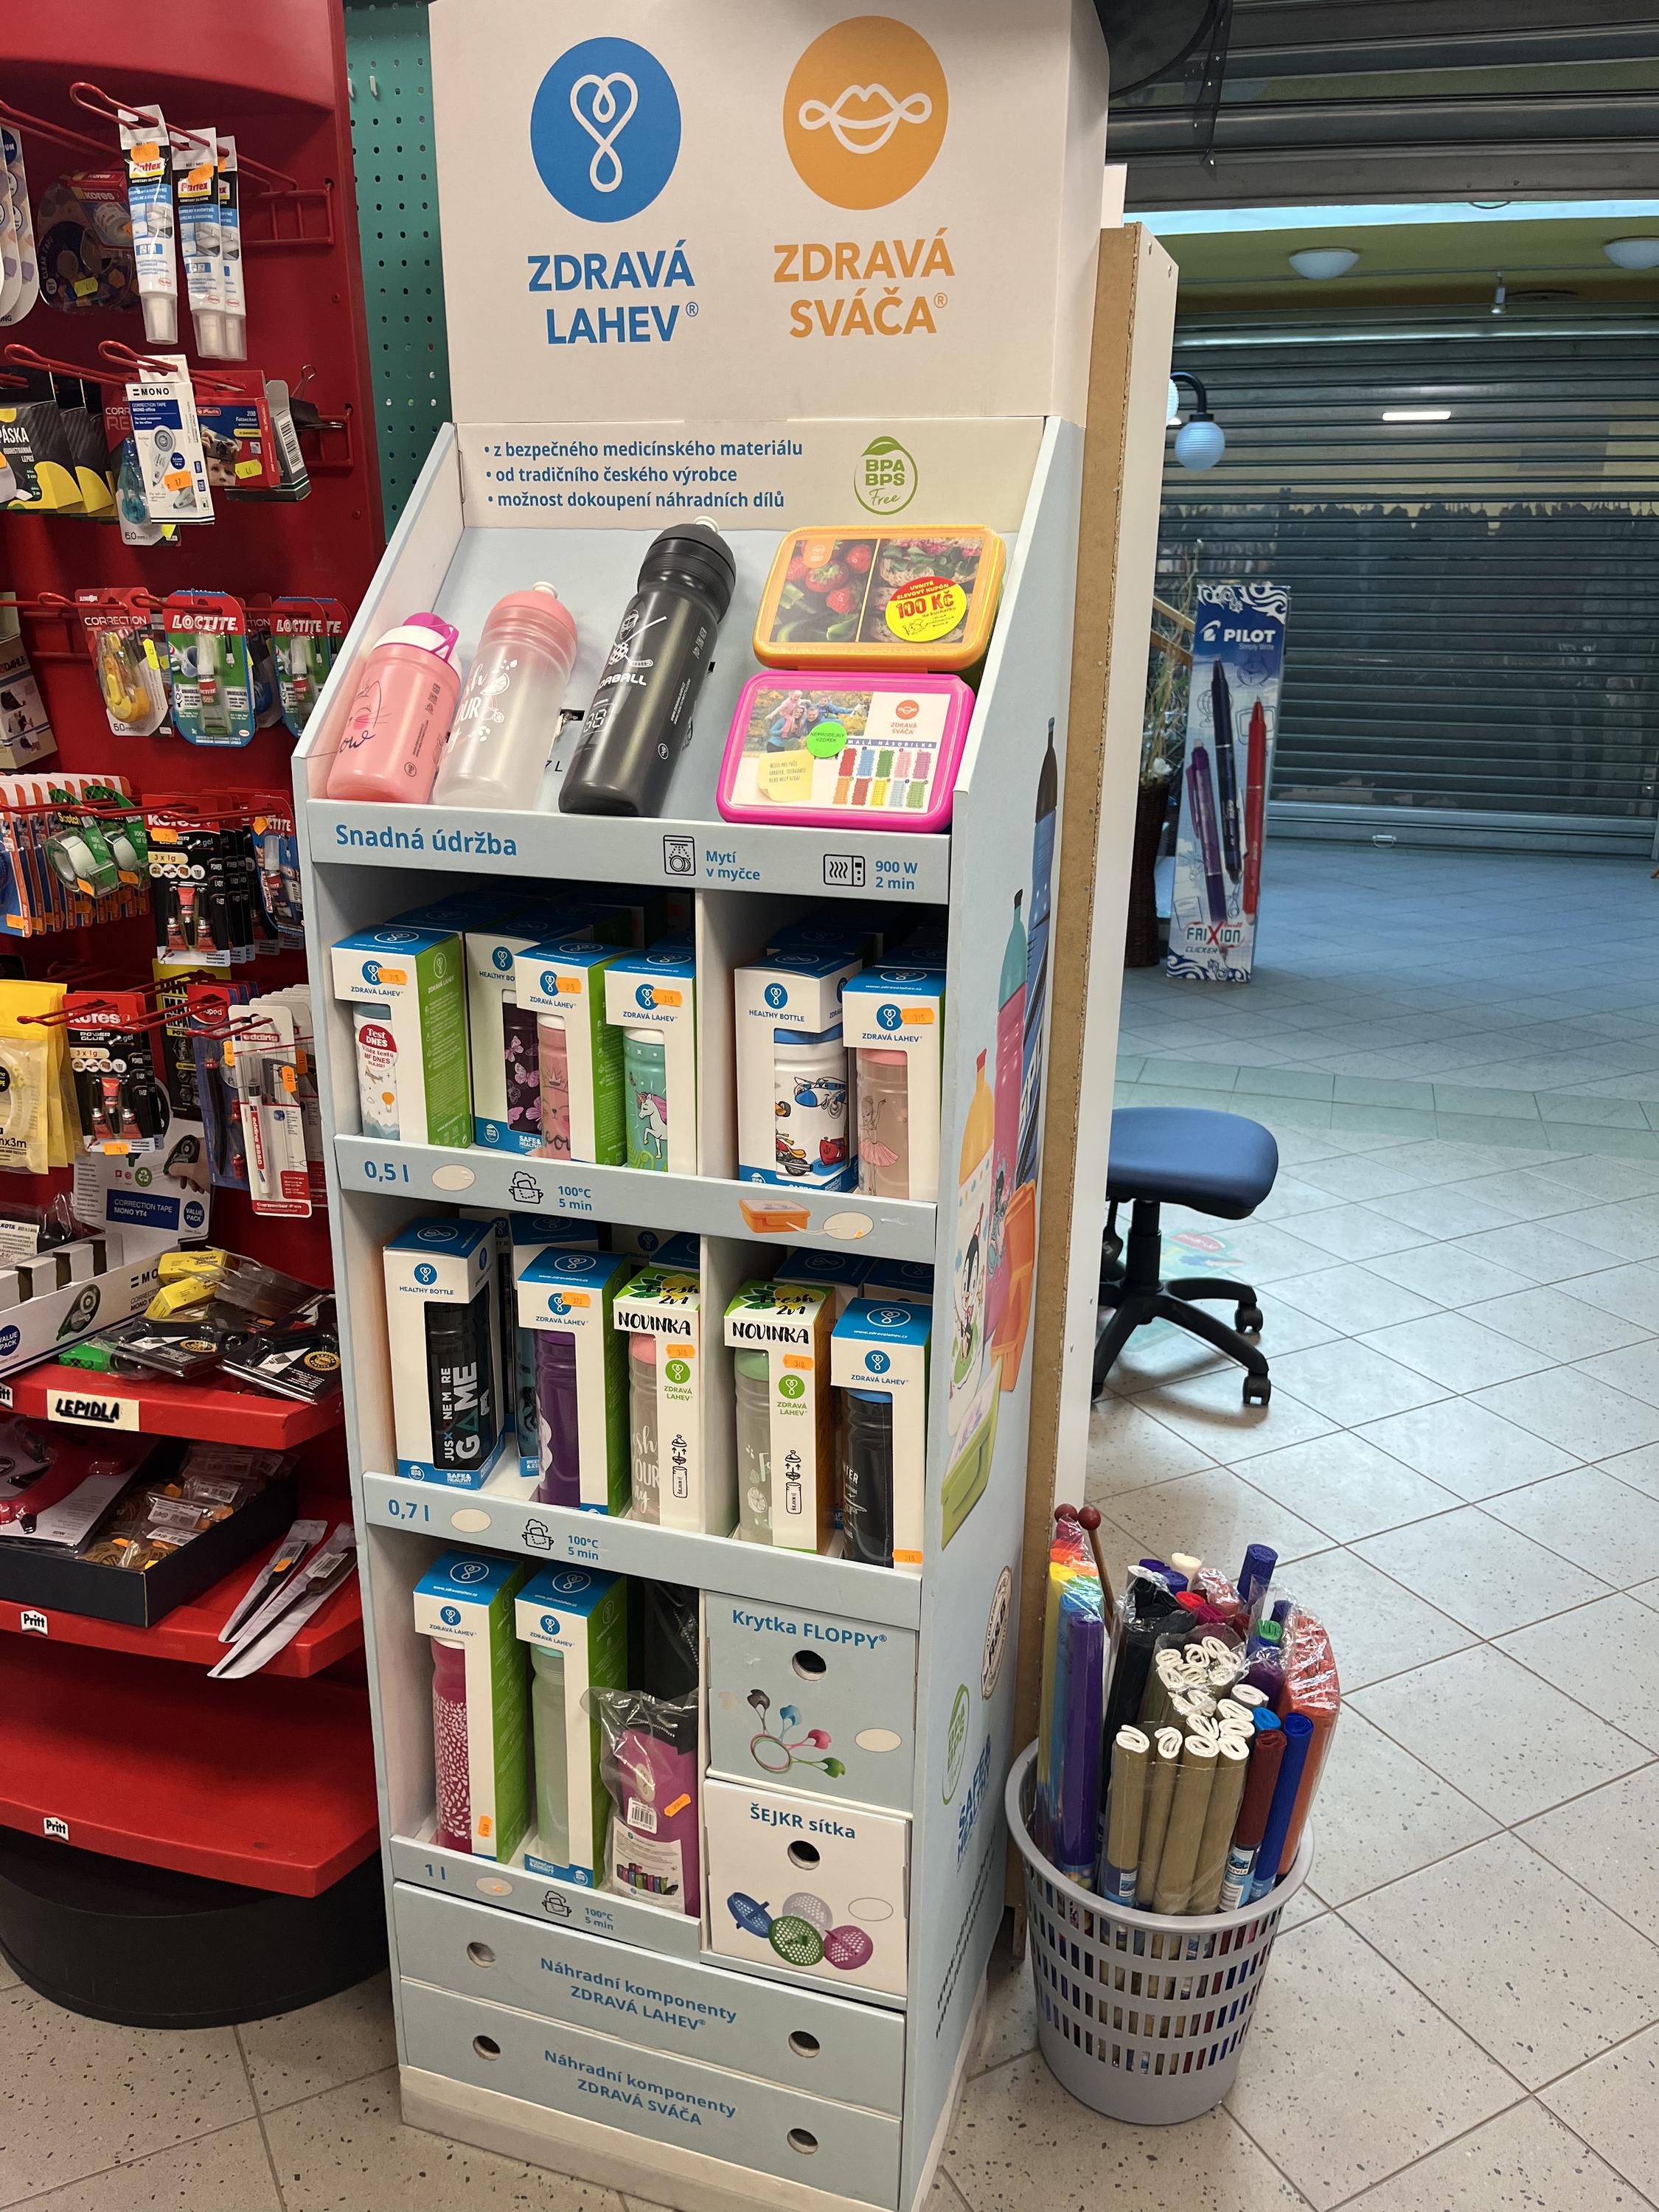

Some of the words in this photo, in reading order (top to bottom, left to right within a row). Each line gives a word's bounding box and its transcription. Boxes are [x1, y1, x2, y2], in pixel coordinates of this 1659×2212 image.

[773, 227, 955, 282] ZDRAVÁ
[527, 240, 695, 292] ZDRAVÁ
[141, 388, 170, 396] MONO
[494, 444, 502, 456] z
[505, 439, 599, 460] bezpečného
[602, 439, 716, 458] medicínského
[721, 439, 802, 457] materiálu
[866, 459, 905, 473] BPA
[495, 467, 514, 482] od
[518, 466, 599, 483] tradičního
[603, 465, 668, 483] českého
[672, 465, 737, 487] výrobce
[865, 472, 905, 486] BPS
[497, 492, 563, 509] možnost
[567, 491, 652, 512] dokoupení
[656, 490, 748, 509] náhradních
[753, 490, 785, 509] dílů
[869, 488, 901, 508] Free
[897, 588, 925, 600] SLEVOVÝ
[926, 583, 949, 593] KUPÓN
[896, 598, 927, 619] 100
[84, 616, 147, 626] CORRECTION
[1223, 628, 1276, 643] PILOT
[336, 823, 425, 851] Snadná
[432, 830, 518, 857] údržba
[706, 850, 737, 864] Mytí
[875, 860, 900, 874] 900
[902, 862, 918, 874] W
[706, 869, 712, 877] v
[714, 867, 761, 882] myčce
[875, 876, 883, 888] 2
[887, 877, 915, 891] min
[1186, 946, 1219, 954] CLICKER
[479, 971, 505, 981] HEALTHY
[351, 986, 378, 995] ZDRAVÁ
[378, 989, 401, 998] LAHEV
[529, 995, 554, 1006] ZDRAVÁ
[554, 1000, 574, 1009] LAHEV
[622, 1010, 650, 1020] ZDRAVÁ
[651, 1013, 675, 1023] LAHEV
[748, 1009, 778, 1020] HEALTHY
[779, 1012, 805, 1023] BOTTLE
[243, 1033, 279, 1042] edding
[367, 1027, 386, 1040] Test
[862, 1032, 892, 1041] ZDRAVÁ
[894, 1034, 919, 1043] LAHEV
[366, 1035, 389, 1048] DNES
[372, 1055, 391, 1065] DNES
[364, 1160, 397, 1183] 0,5
[557, 1185, 591, 1198] 100°C
[114, 1198, 156, 1211] CORRECTION
[156, 1204, 173, 1214] TAPE
[559, 1197, 566, 1208] 5
[568, 1200, 593, 1211] min
[114, 1206, 133, 1215] MONO
[135, 1208, 147, 1217] YT4
[185, 1207, 204, 1216] VALUE
[186, 1214, 201, 1222] PACK
[399, 1286, 428, 1295] HEALTHY
[535, 1315, 563, 1324] ZDRAVÁ
[563, 1318, 586, 1326] LAHEV
[618, 1311, 692, 1336] NOVINKA
[732, 1321, 810, 1345] NOVINKA
[851, 1374, 880, 1383] ZDRAVÁ
[880, 1377, 906, 1385] LAHEV
[664, 1385, 693, 1395] ZDRAVÁ
[667, 1392, 691, 1402] LAHEV
[55, 1398, 119, 1422] LEPIDLA
[777, 1401, 807, 1410] ZDRAVÁ
[779, 1408, 804, 1416] LAHEV
[388, 1498, 418, 1520] 0,7
[568, 1534, 599, 1548] 100°C
[568, 1547, 574, 1556] 5
[577, 1549, 599, 1560] min
[24, 1613, 45, 1628] Pritt
[731, 1609, 797, 1635] Krytka
[429, 1623, 453, 1634] ZDRAVÁ
[453, 1628, 475, 1638] LAHEV
[529, 1631, 553, 1643] ZDRAVÁ
[553, 1636, 573, 1647] LAHEV
[45, 1818, 66, 1834] Pritt
[749, 1801, 803, 1830] ŠEJKR
[809, 1818, 856, 1840] sítka
[425, 1863, 434, 1877] 1
[584, 1907, 614, 1921] 100°C
[594, 1919, 614, 1930] min
[540, 1957, 621, 1991] Náhradní
[625, 1976, 737, 2024] komponenty
[570, 1983, 639, 2014] ZDRAVÁ
[544, 2049, 623, 2083] Náhradní
[626, 2067, 736, 2118] komponenty
[577, 2078, 644, 2107] ZDRAVÁ
[647, 2096, 702, 2126] SVÁČA
